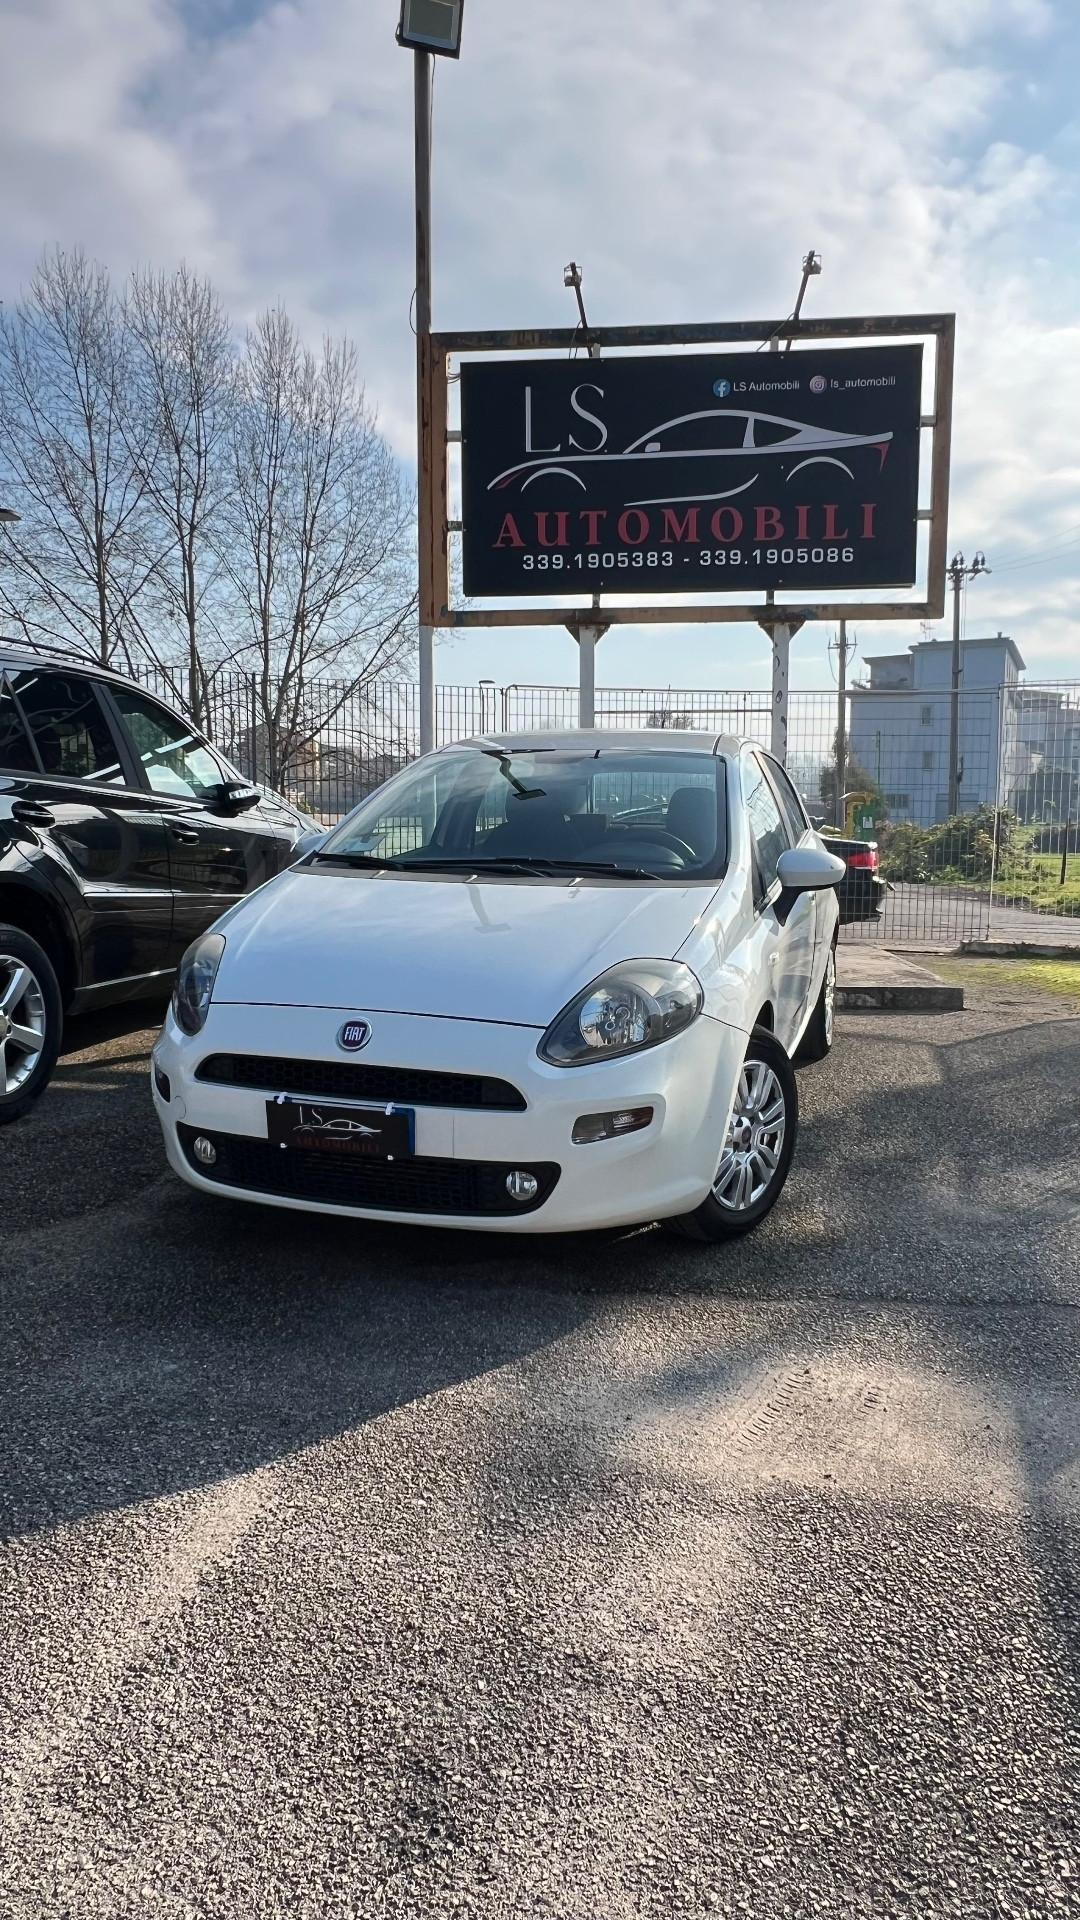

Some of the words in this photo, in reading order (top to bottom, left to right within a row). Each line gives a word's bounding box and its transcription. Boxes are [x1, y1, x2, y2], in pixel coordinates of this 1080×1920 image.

[733, 381, 747, 392] LS
[749, 380, 800, 391] Automobili
[830, 376, 896, 390] ls_automobili
[491, 503, 877, 548] AUTOMOBILI
[522, 551, 673, 570] 339.1905383
[699, 548, 854, 566] 339.1905086
[344, 1026, 366, 1041] FIAT
